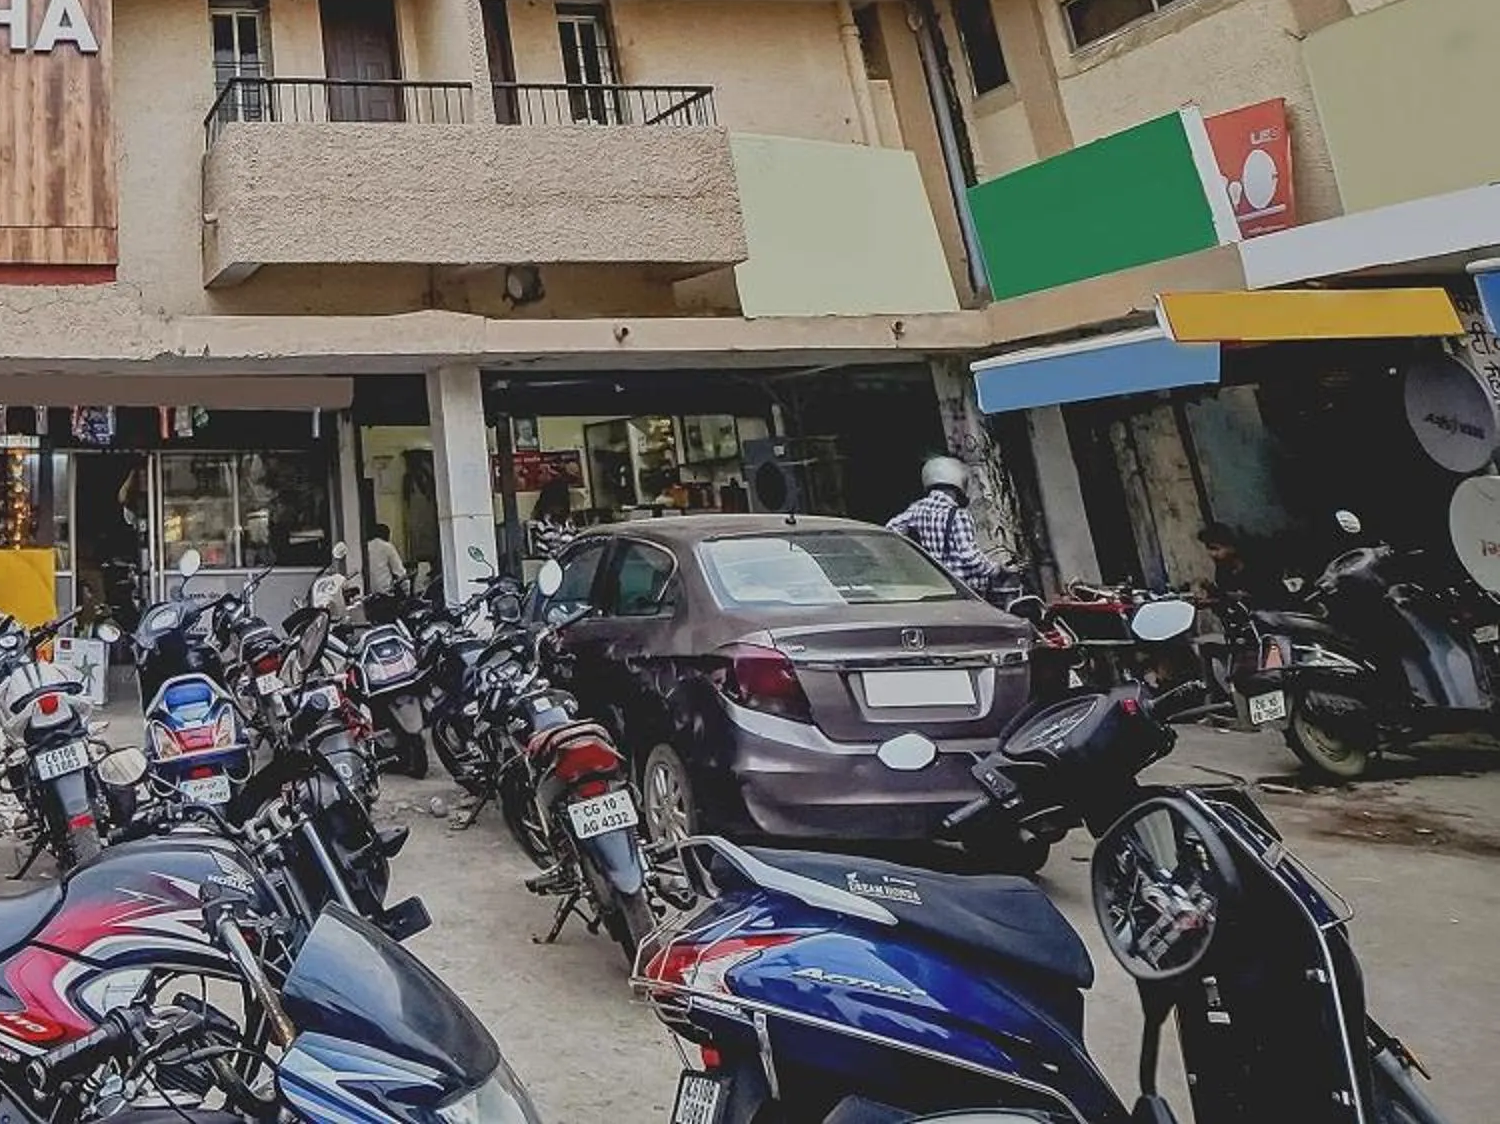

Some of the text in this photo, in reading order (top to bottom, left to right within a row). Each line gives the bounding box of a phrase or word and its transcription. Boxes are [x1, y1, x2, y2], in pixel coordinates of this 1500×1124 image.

[583, 797, 617, 817] CG 10
[207, 875, 256, 895] HONDA
